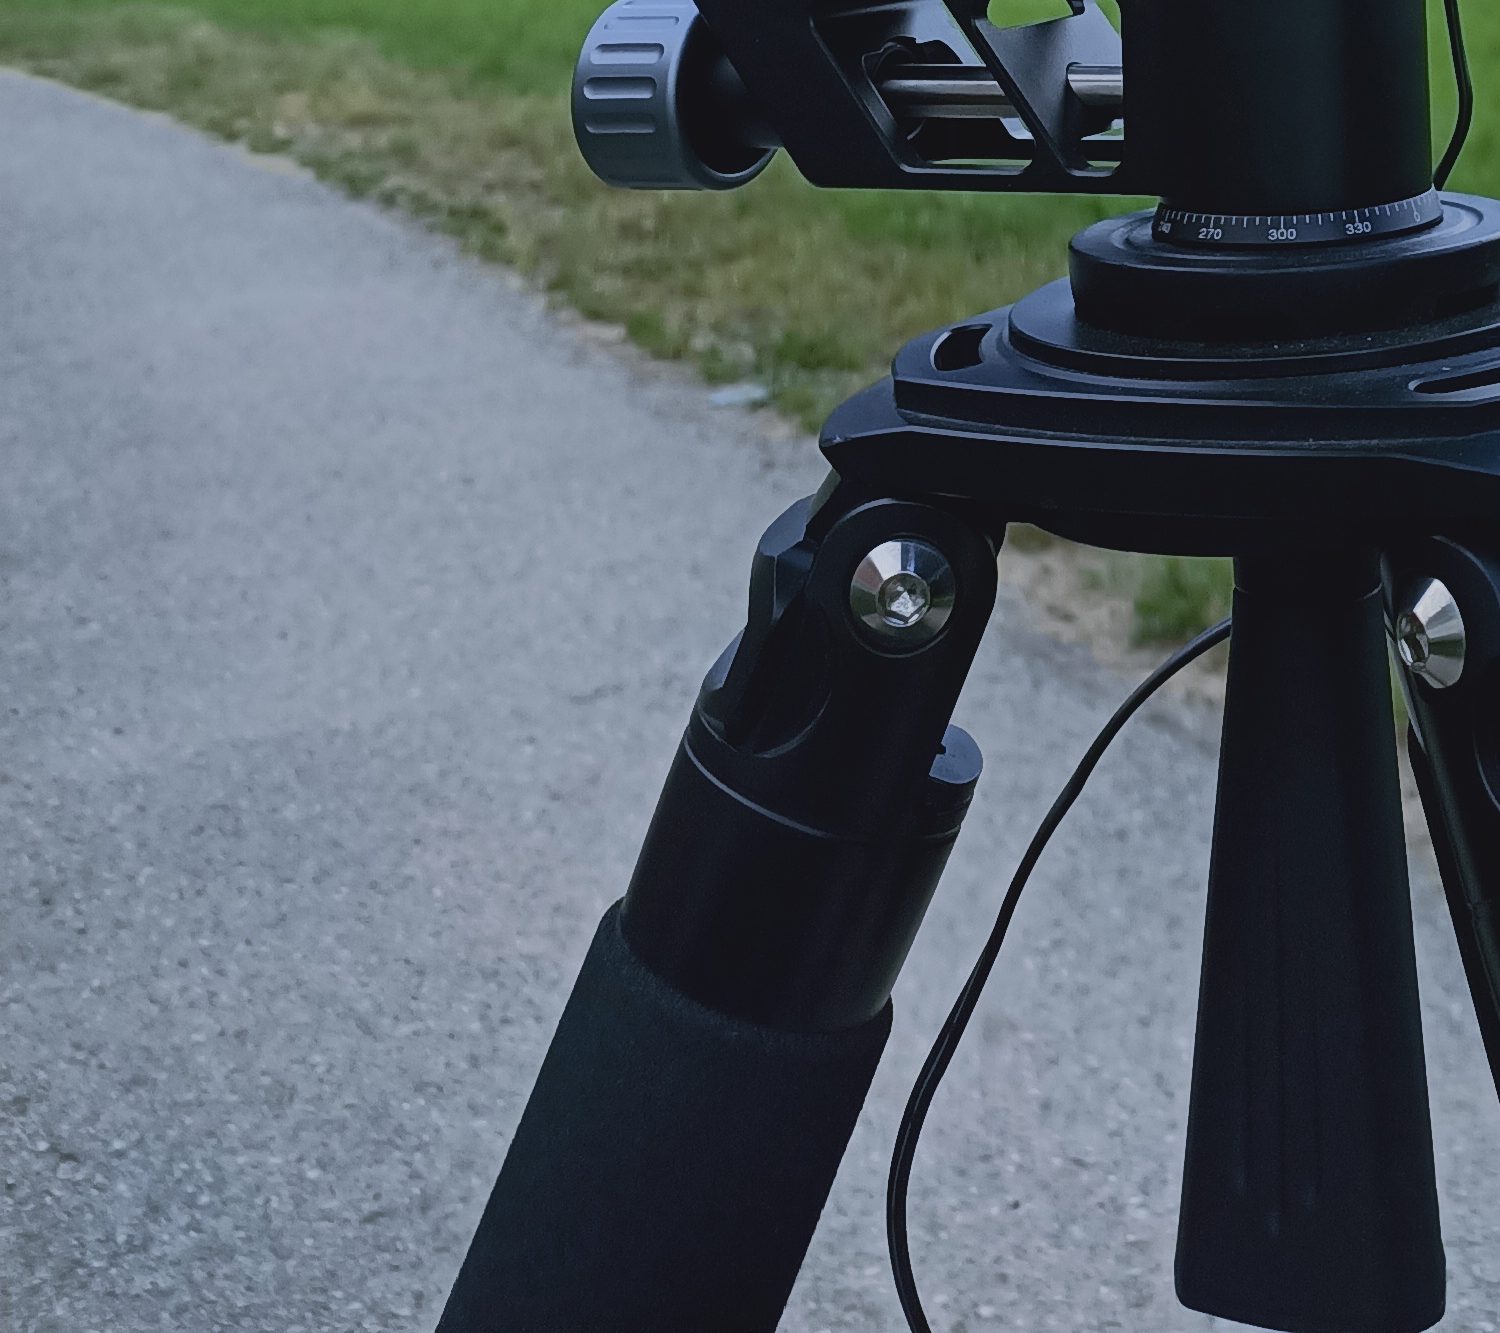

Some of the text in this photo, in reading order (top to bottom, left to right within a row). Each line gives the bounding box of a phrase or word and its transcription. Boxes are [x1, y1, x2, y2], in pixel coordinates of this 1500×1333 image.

[1198, 227, 1222, 240] 270
[1268, 228, 1297, 241] 300
[1345, 221, 1372, 235] 330
